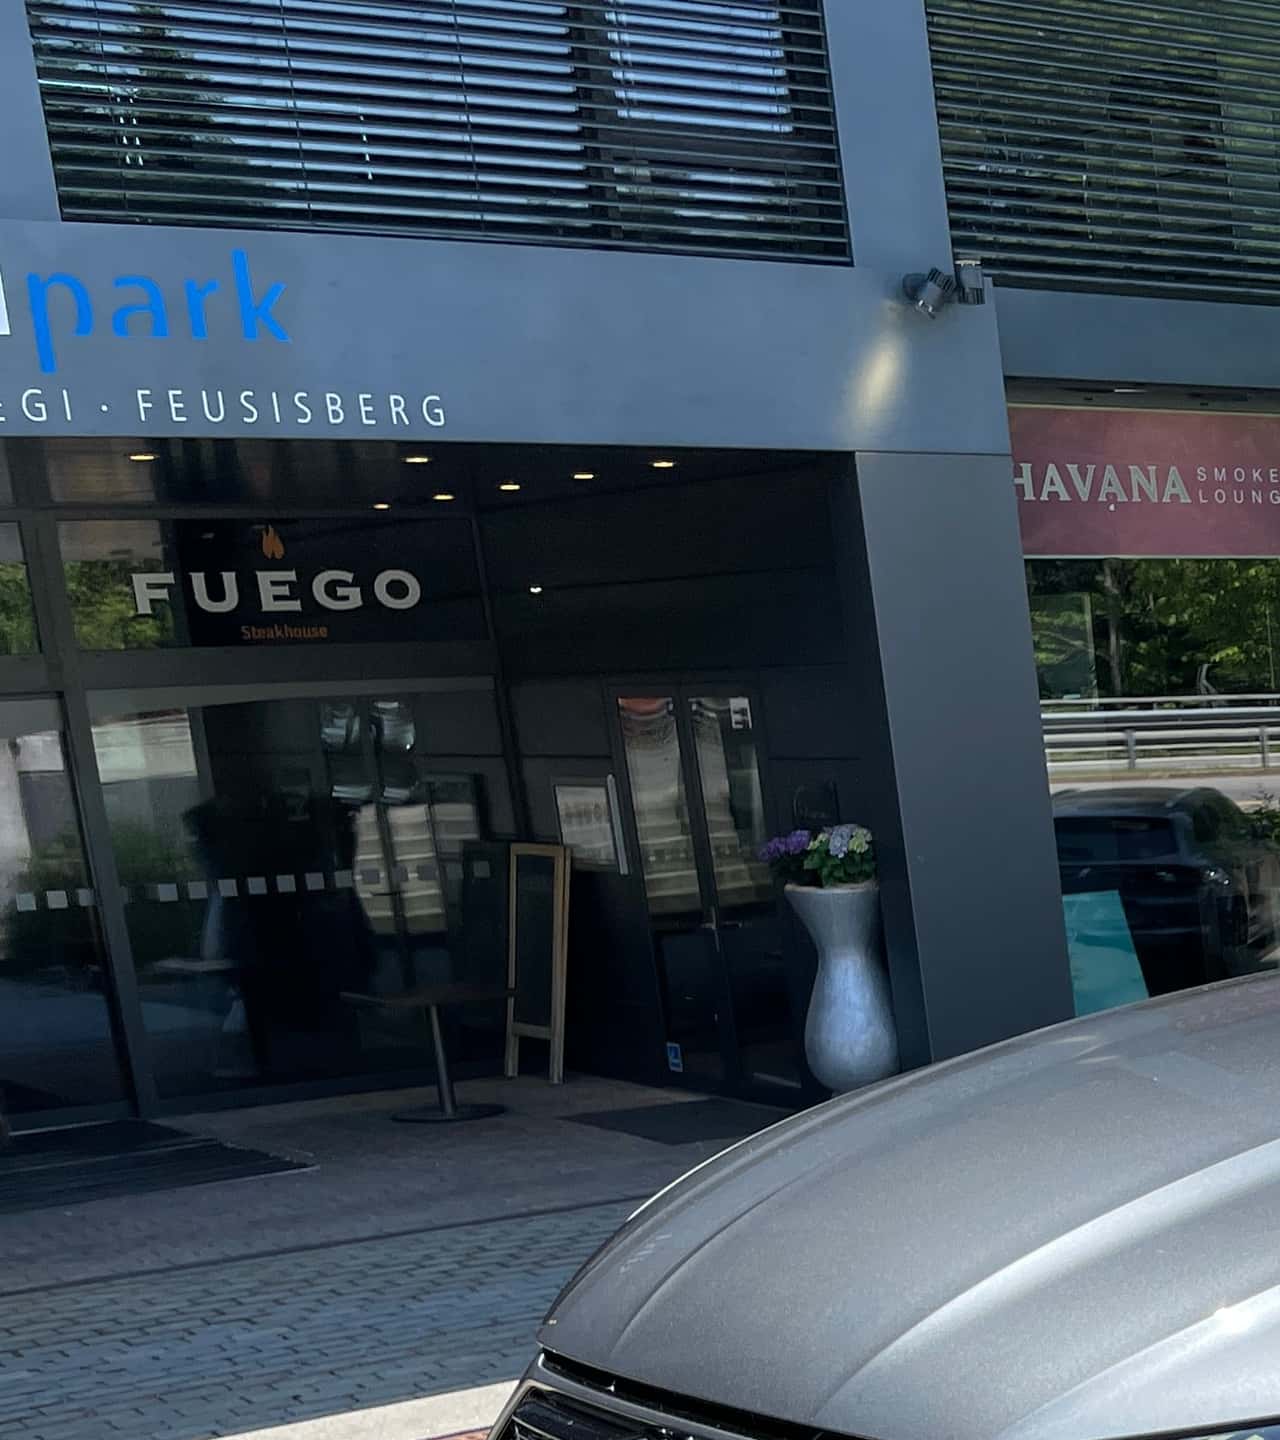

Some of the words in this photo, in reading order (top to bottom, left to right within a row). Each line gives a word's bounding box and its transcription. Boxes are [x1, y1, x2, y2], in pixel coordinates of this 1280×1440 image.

[0, 247, 291, 374] park
[136, 388, 449, 427] FEUSISBERG
[131, 568, 422, 616] FUEGO
[241, 624, 328, 641] Steakhouse
